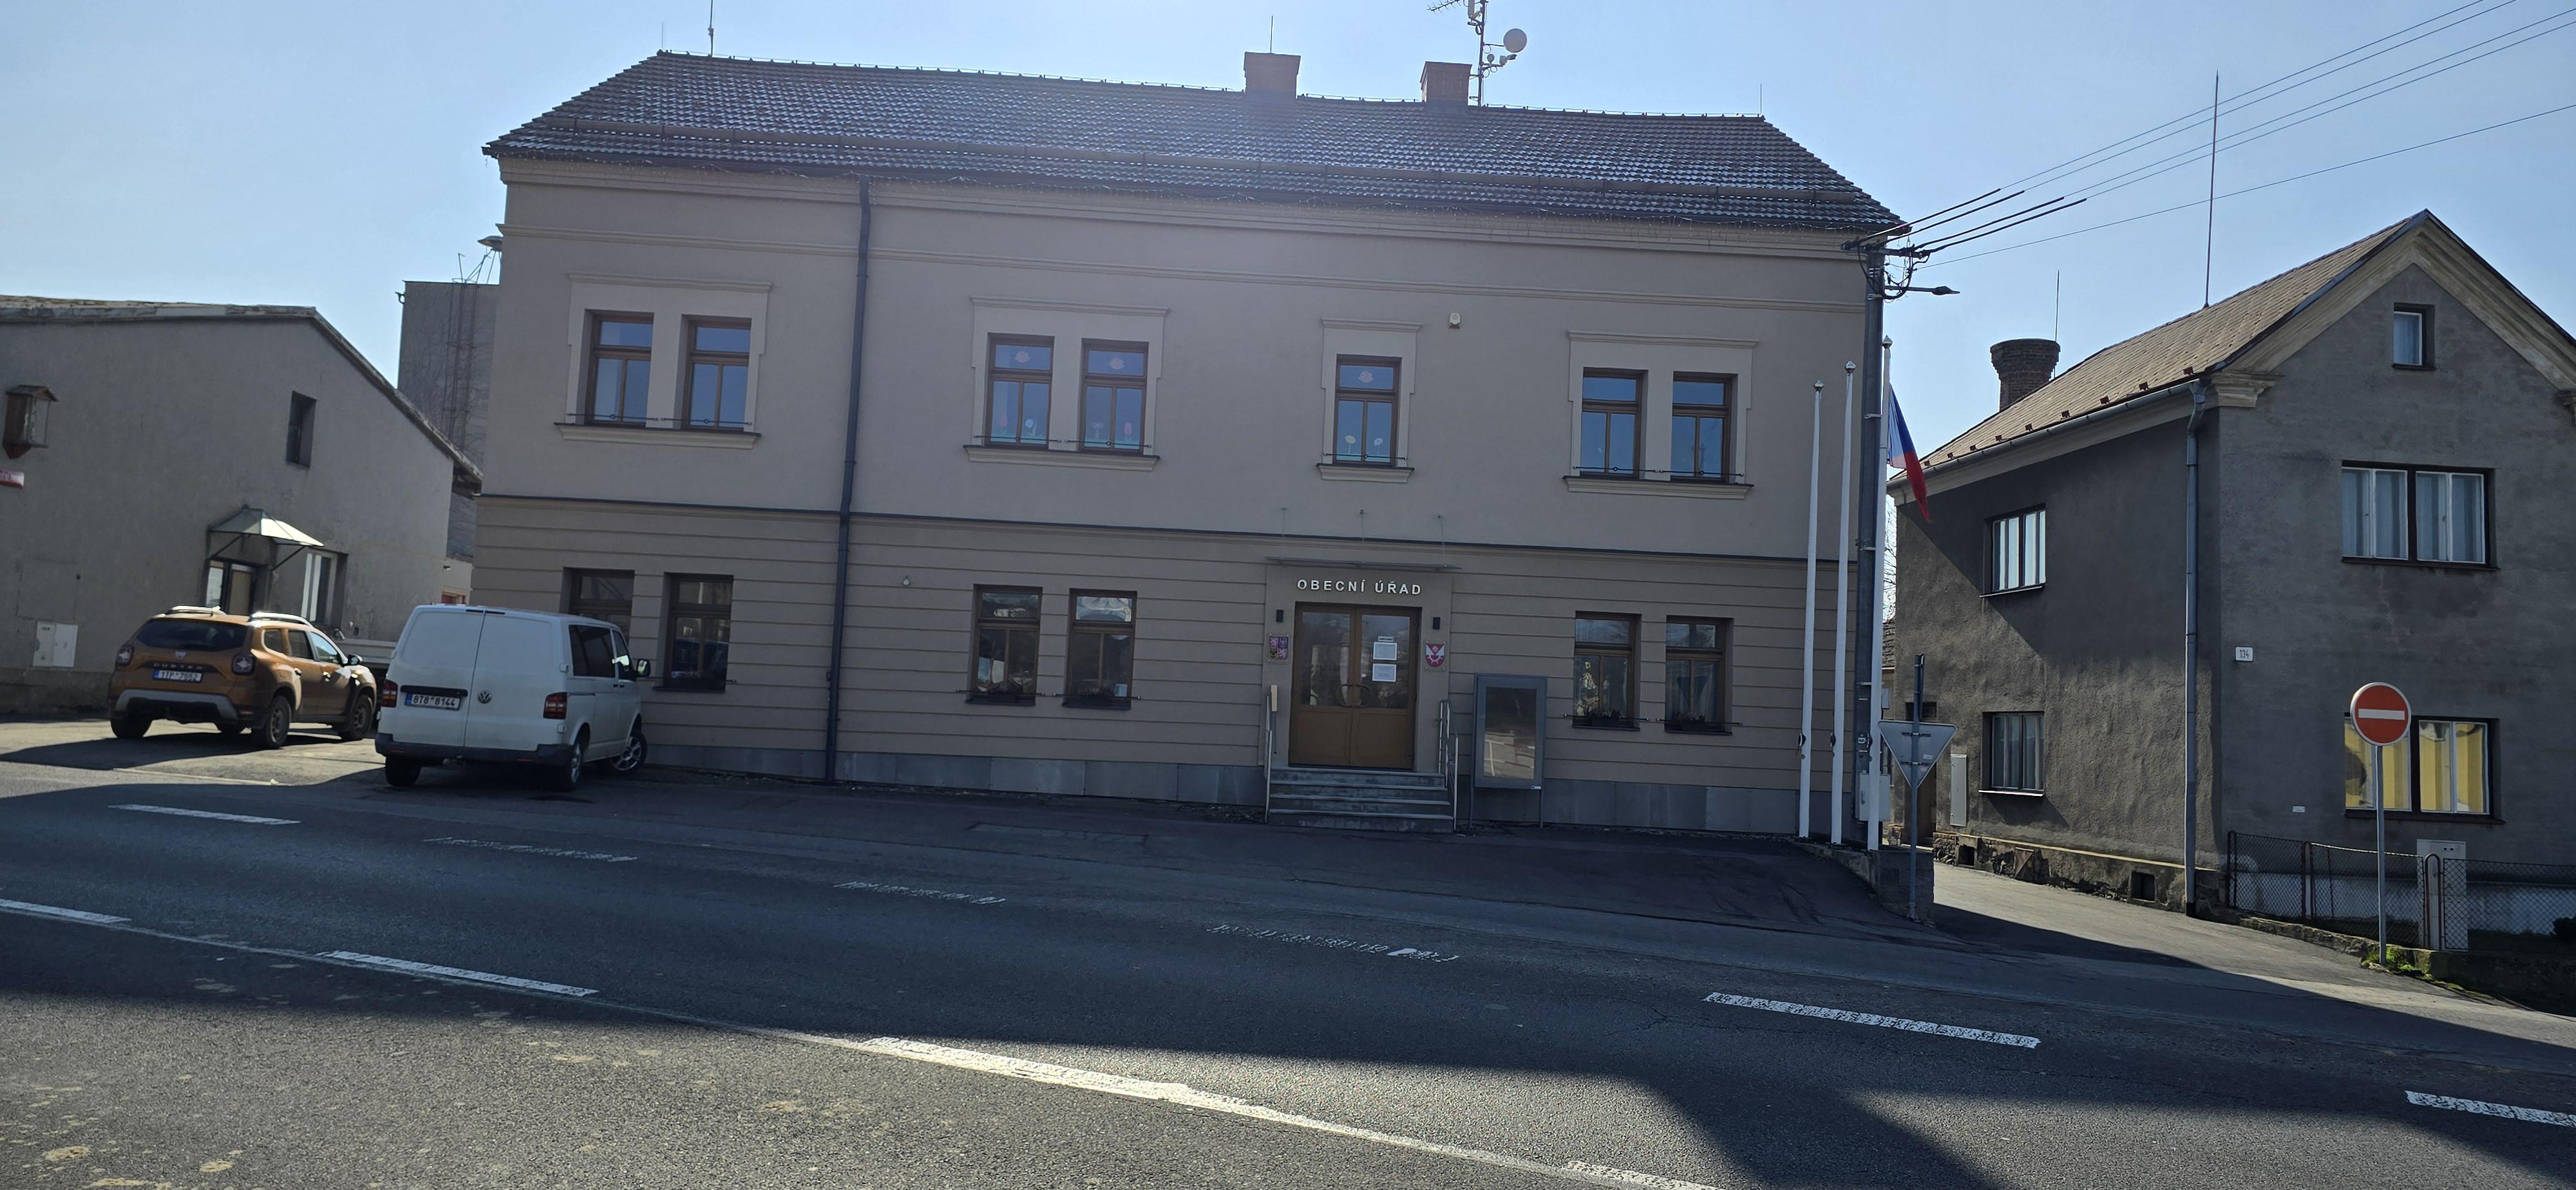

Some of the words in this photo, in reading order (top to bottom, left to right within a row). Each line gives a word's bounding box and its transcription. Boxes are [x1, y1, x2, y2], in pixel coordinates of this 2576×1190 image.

[1297, 580, 1365, 592] OBECNÍ
[1375, 580, 1421, 595] ÚŘAD
[2240, 649, 2249, 659] 134
